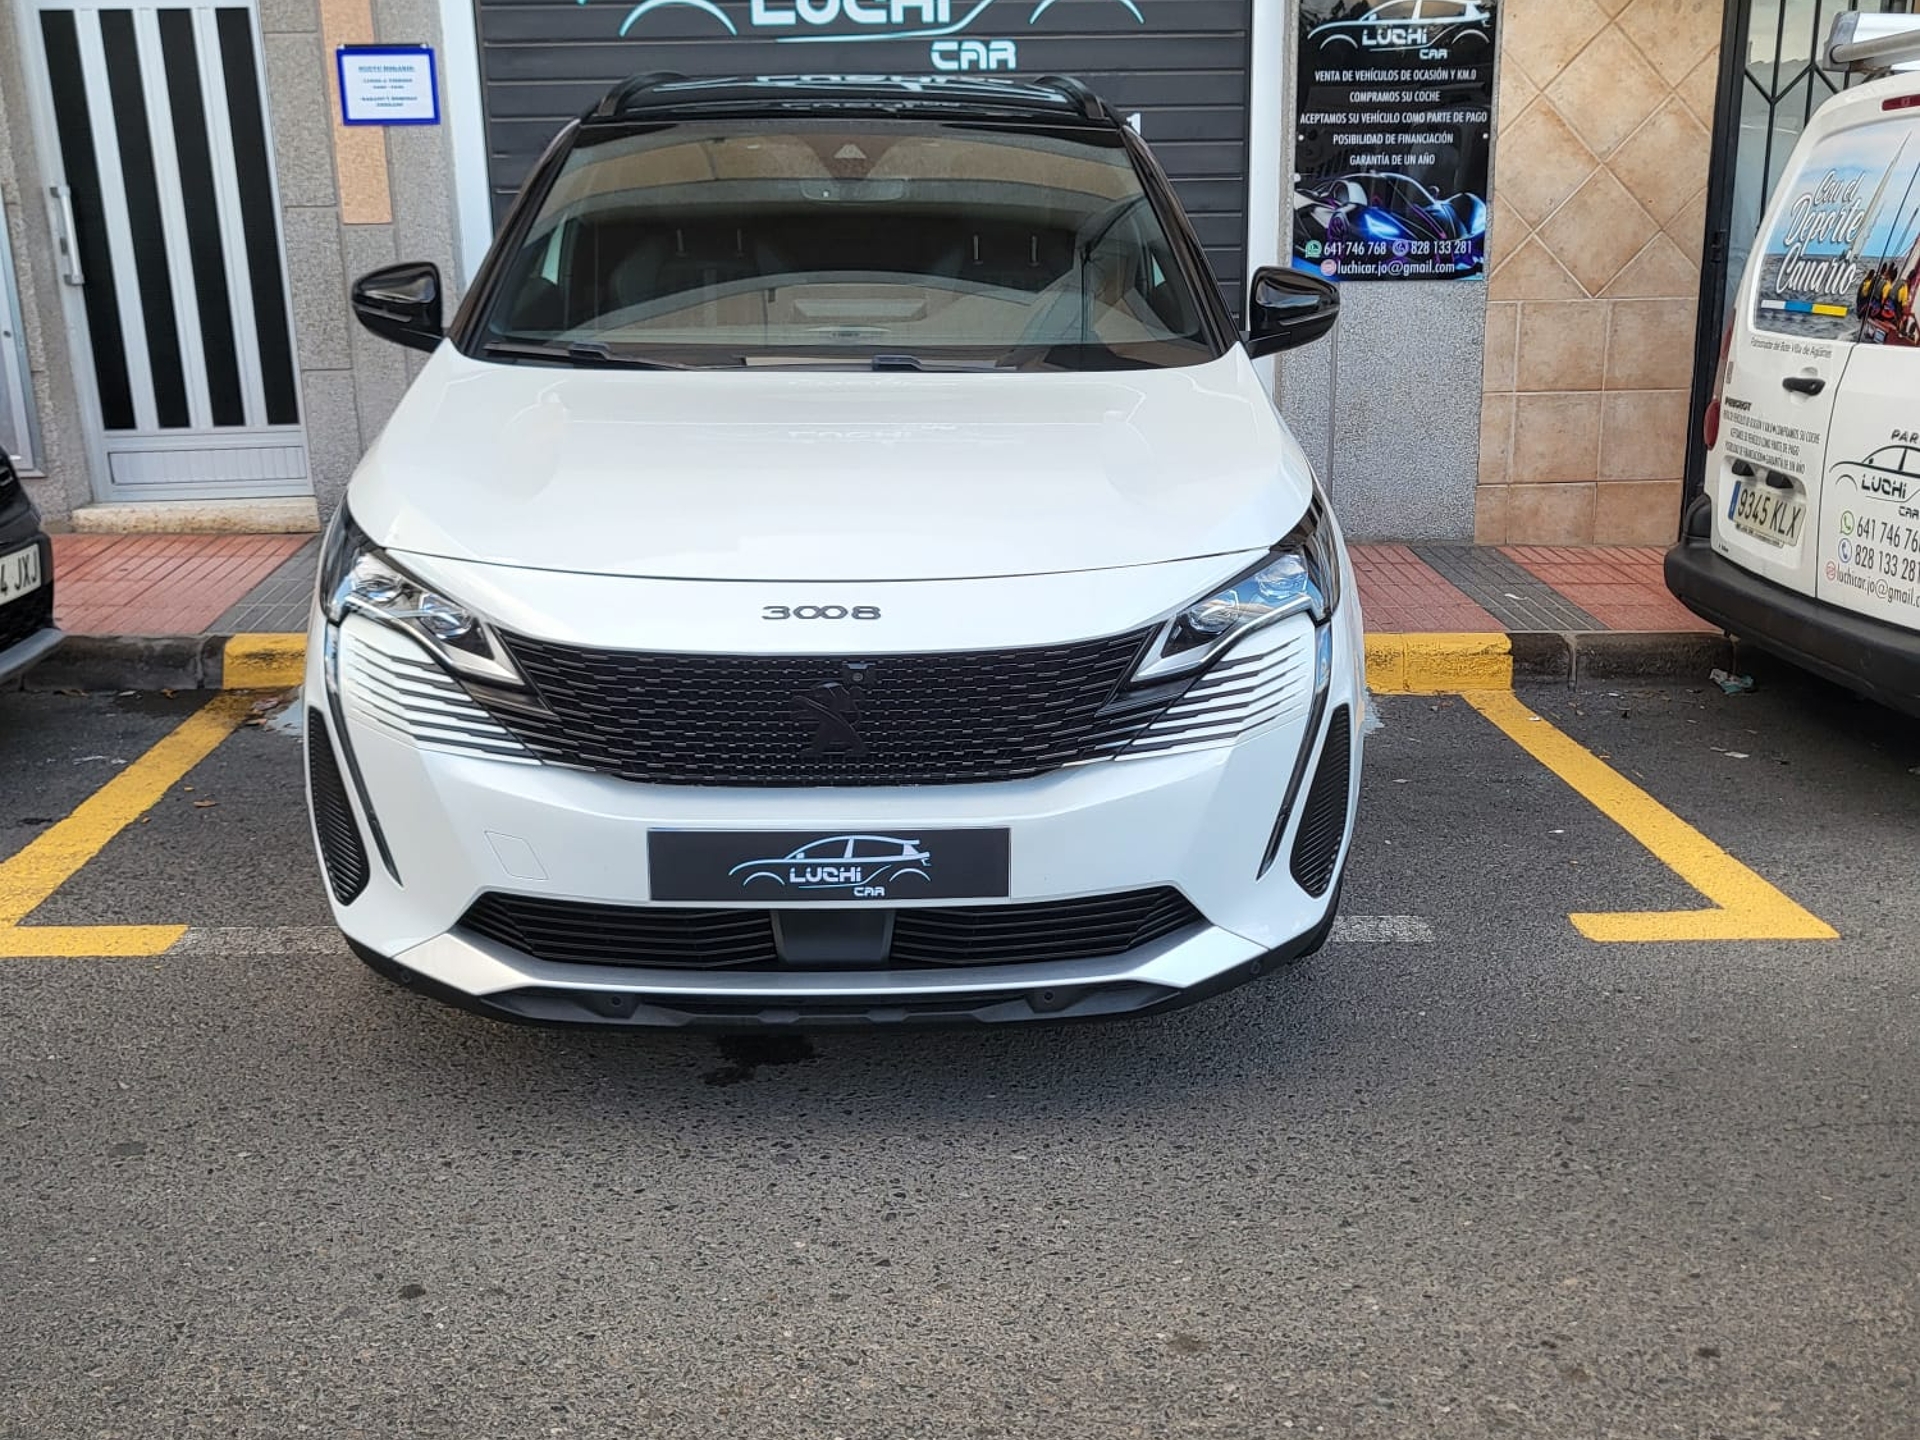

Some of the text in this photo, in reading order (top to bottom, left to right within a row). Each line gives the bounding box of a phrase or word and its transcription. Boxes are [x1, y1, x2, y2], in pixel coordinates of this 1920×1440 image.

[1362, 28, 1428, 46] LUCHI
[931, 40, 1017, 70] CAR
[1419, 49, 1448, 60] CAR
[1314, 70, 1341, 82] VENTA
[1342, 70, 1353, 81] DE
[1355, 67, 1399, 81] VEHÍCULOS
[1401, 69, 1412, 80] DE
[1413, 67, 1448, 80] OCASIÓN
[1450, 69, 1456, 80] Y
[1350, 91, 1441, 103] COMPRAMOS SU COCHE
[1300, 110, 1487, 124] ACEPTAMOS SU VEHÍCULO COMO PARTE DE PAGO
[1333, 131, 1454, 145] POSIBILIDAD DE FINANCIACIÓN
[1350, 152, 1435, 166] GARANTÍA DE UN AÑO
[1814, 168, 1866, 205] Con el
[1784, 193, 1866, 257] Deporte
[1324, 240, 1472, 256] 641 746 768 828 133 281
[1338, 260, 1455, 277] luchicar.jo@gmail.com
[1775, 242, 1857, 295] Canario
[1891, 429, 1919, 443] PAR
[1861, 474, 1907, 499] LUCHI
[1737, 488, 1770, 526] 9345
[1769, 500, 1801, 538] KLX
[1898, 505, 1919, 520] CAR
[1857, 516, 1920, 556] 641 746 76
[1855, 544, 1874, 569] 828
[1879, 551, 1898, 577] 133
[14, 551, 38, 591] JXJ
[761, 605, 881, 620] 3008
[789, 866, 862, 882] LUCHI
[853, 886, 885, 897] CAR
